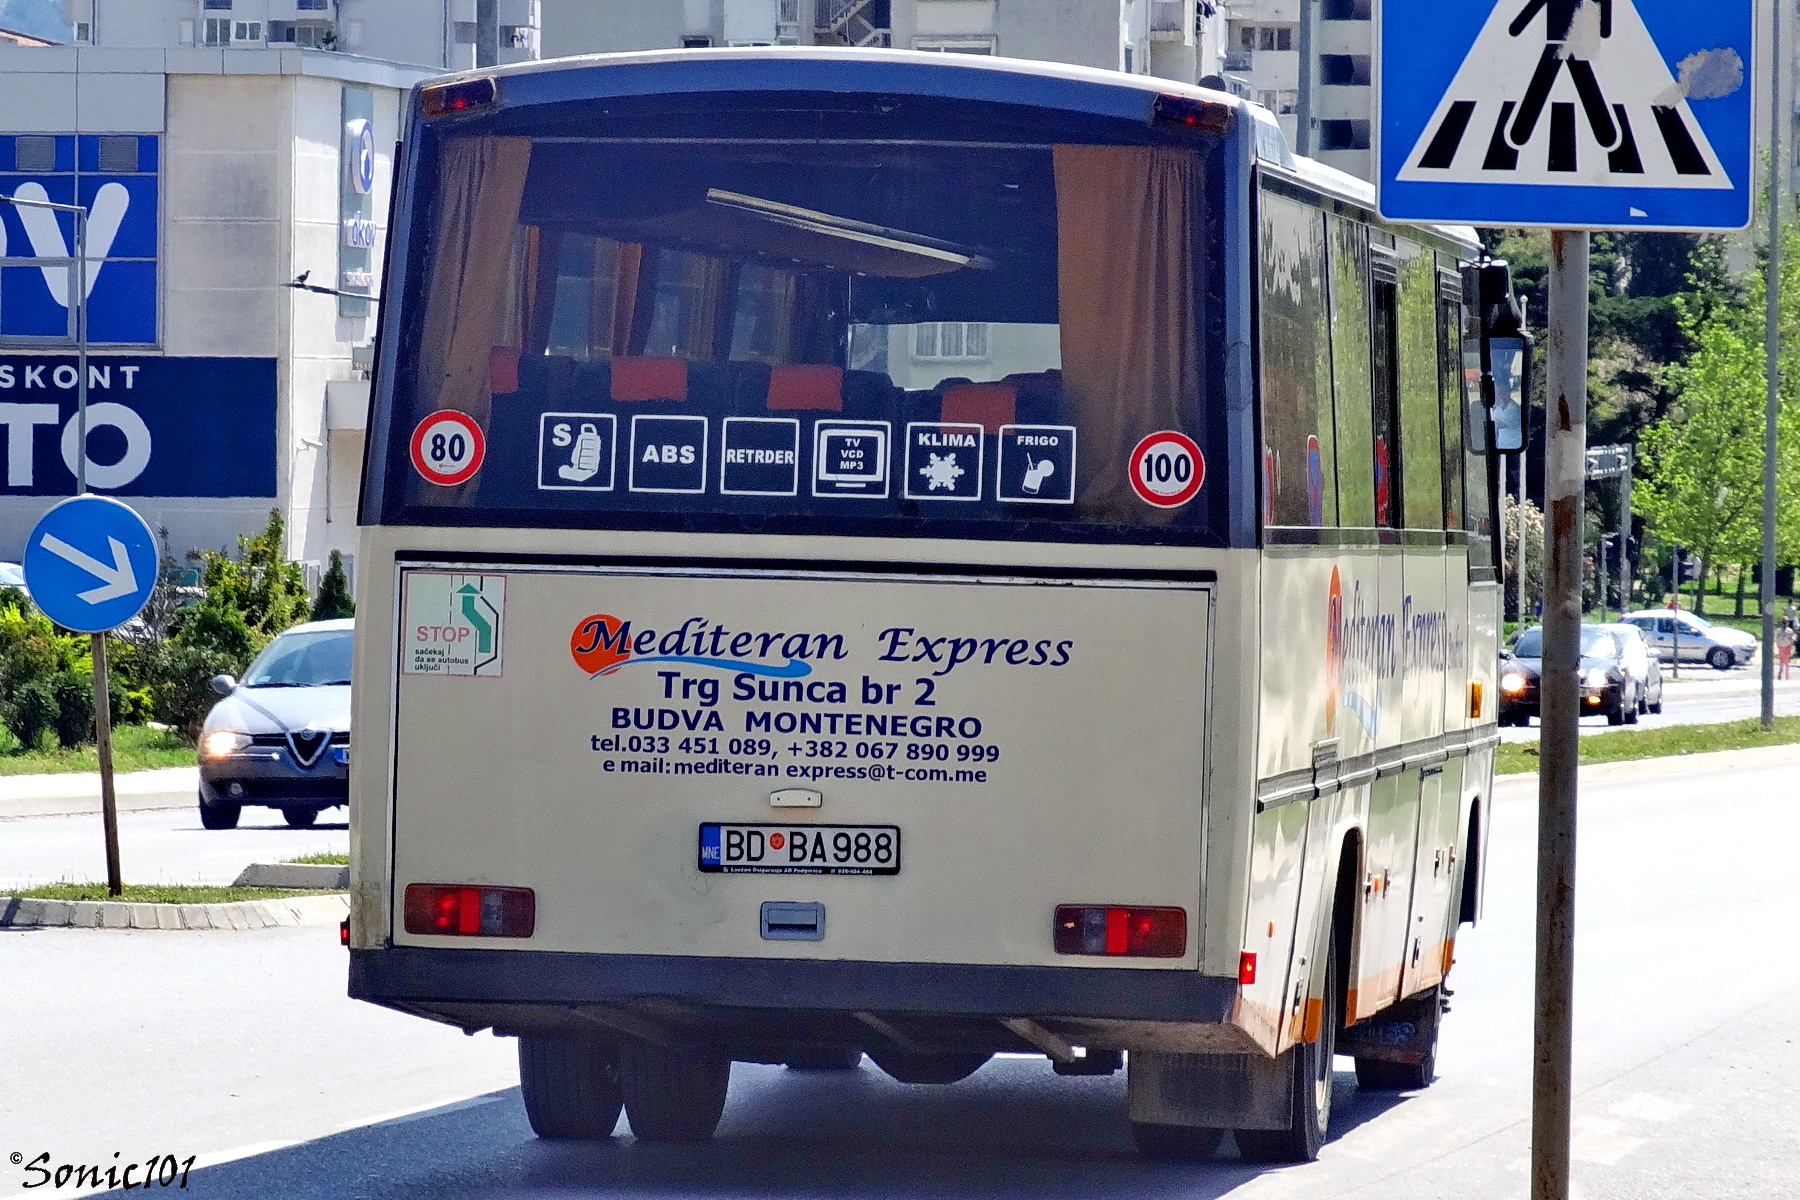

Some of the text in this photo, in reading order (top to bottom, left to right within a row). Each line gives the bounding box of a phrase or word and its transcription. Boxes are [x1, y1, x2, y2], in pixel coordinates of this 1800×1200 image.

[0, 182, 130, 308] V
[0, 365, 140, 389] SKONT
[0, 402, 152, 489] TO
[552, 423, 572, 447] S
[844, 438, 861, 447] TV
[918, 432, 976, 448] KLIMA
[1017, 435, 1059, 447] FRIGO
[431, 433, 465, 462] 80
[642, 445, 695, 464] ABS
[726, 448, 795, 465] RETRDER
[841, 449, 864, 459] VCD
[840, 460, 864, 470] MP3
[1144, 453, 1191, 482] 100
[416, 626, 471, 642] STOP
[575, 617, 1074, 677] Mediteran Express
[658, 671, 936, 707] Trg Sunca br 2
[611, 708, 982, 739] BUDVA MONTENEGRO
[591, 734, 1000, 763] tel.033 451 089, +382 067 890 999
[603, 760, 615, 773] e
[786, 764, 987, 783] express@t-com.me
[702, 846, 720, 860] MNE
[726, 830, 892, 863] BD BA988
